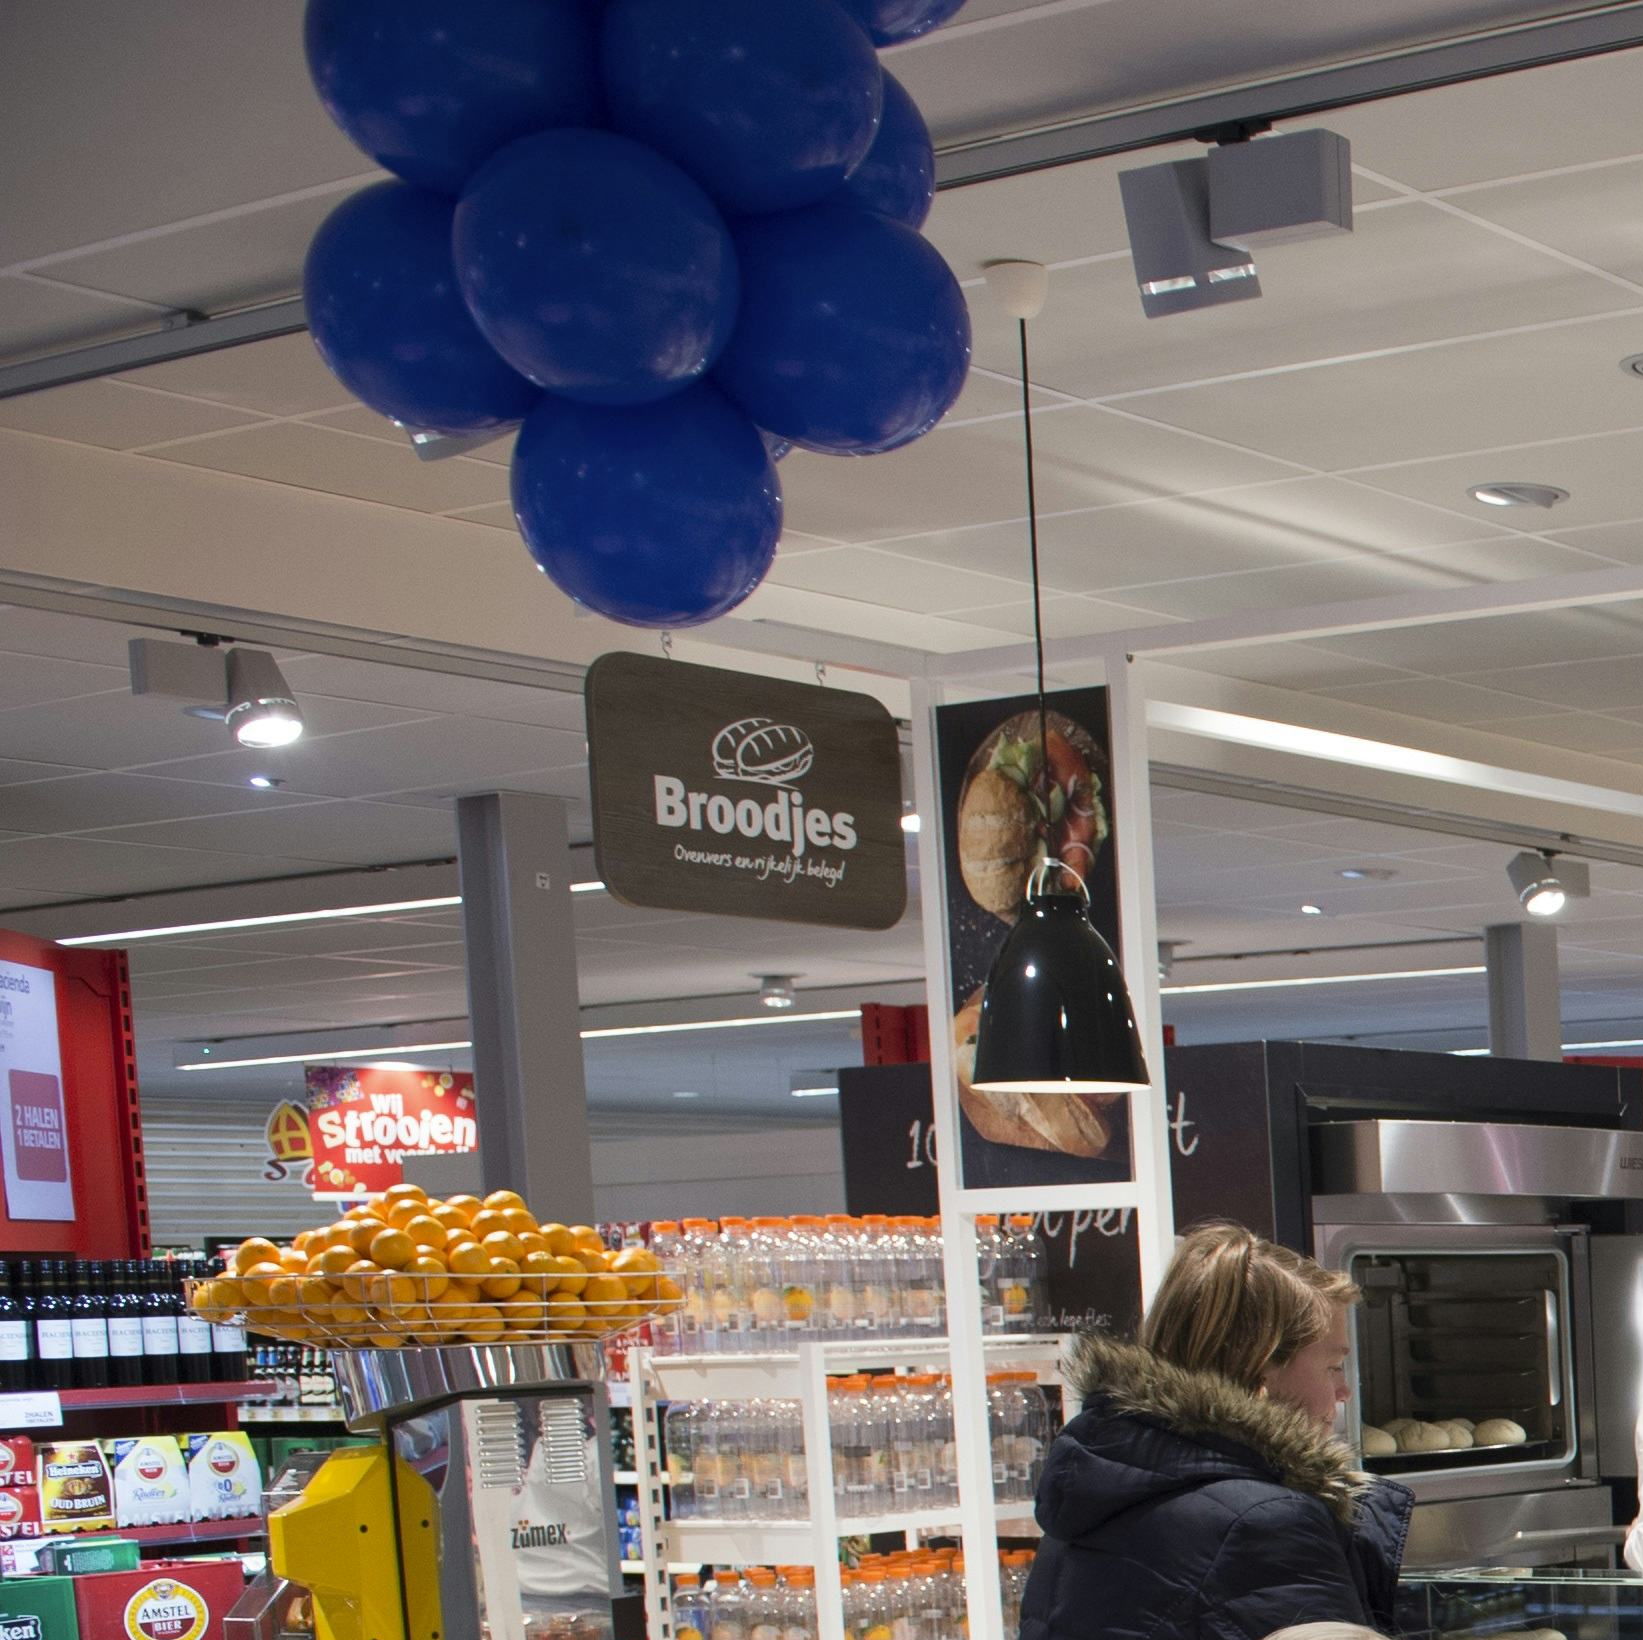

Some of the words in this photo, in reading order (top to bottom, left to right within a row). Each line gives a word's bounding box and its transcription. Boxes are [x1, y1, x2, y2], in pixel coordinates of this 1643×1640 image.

[653, 774, 857, 858] Broodjes
[674, 844, 732, 868] Ovenvers
[807, 858, 846, 889] belegd
[15, 1104, 22, 1126] 2
[23, 1107, 59, 1130] HALEN
[317, 1109, 477, 1148] Strooien
[17, 1129, 23, 1147] 1
[23, 1130, 61, 1149] BETALEN
[345, 1145, 382, 1164] met
[48, 1463, 101, 1477] Heineken
[51, 1497, 73, 1509] OUD
[73, 1494, 106, 1508] BRUIN
[141, 1604, 191, 1621] AMSTEL
[154, 1621, 182, 1631] BIER
